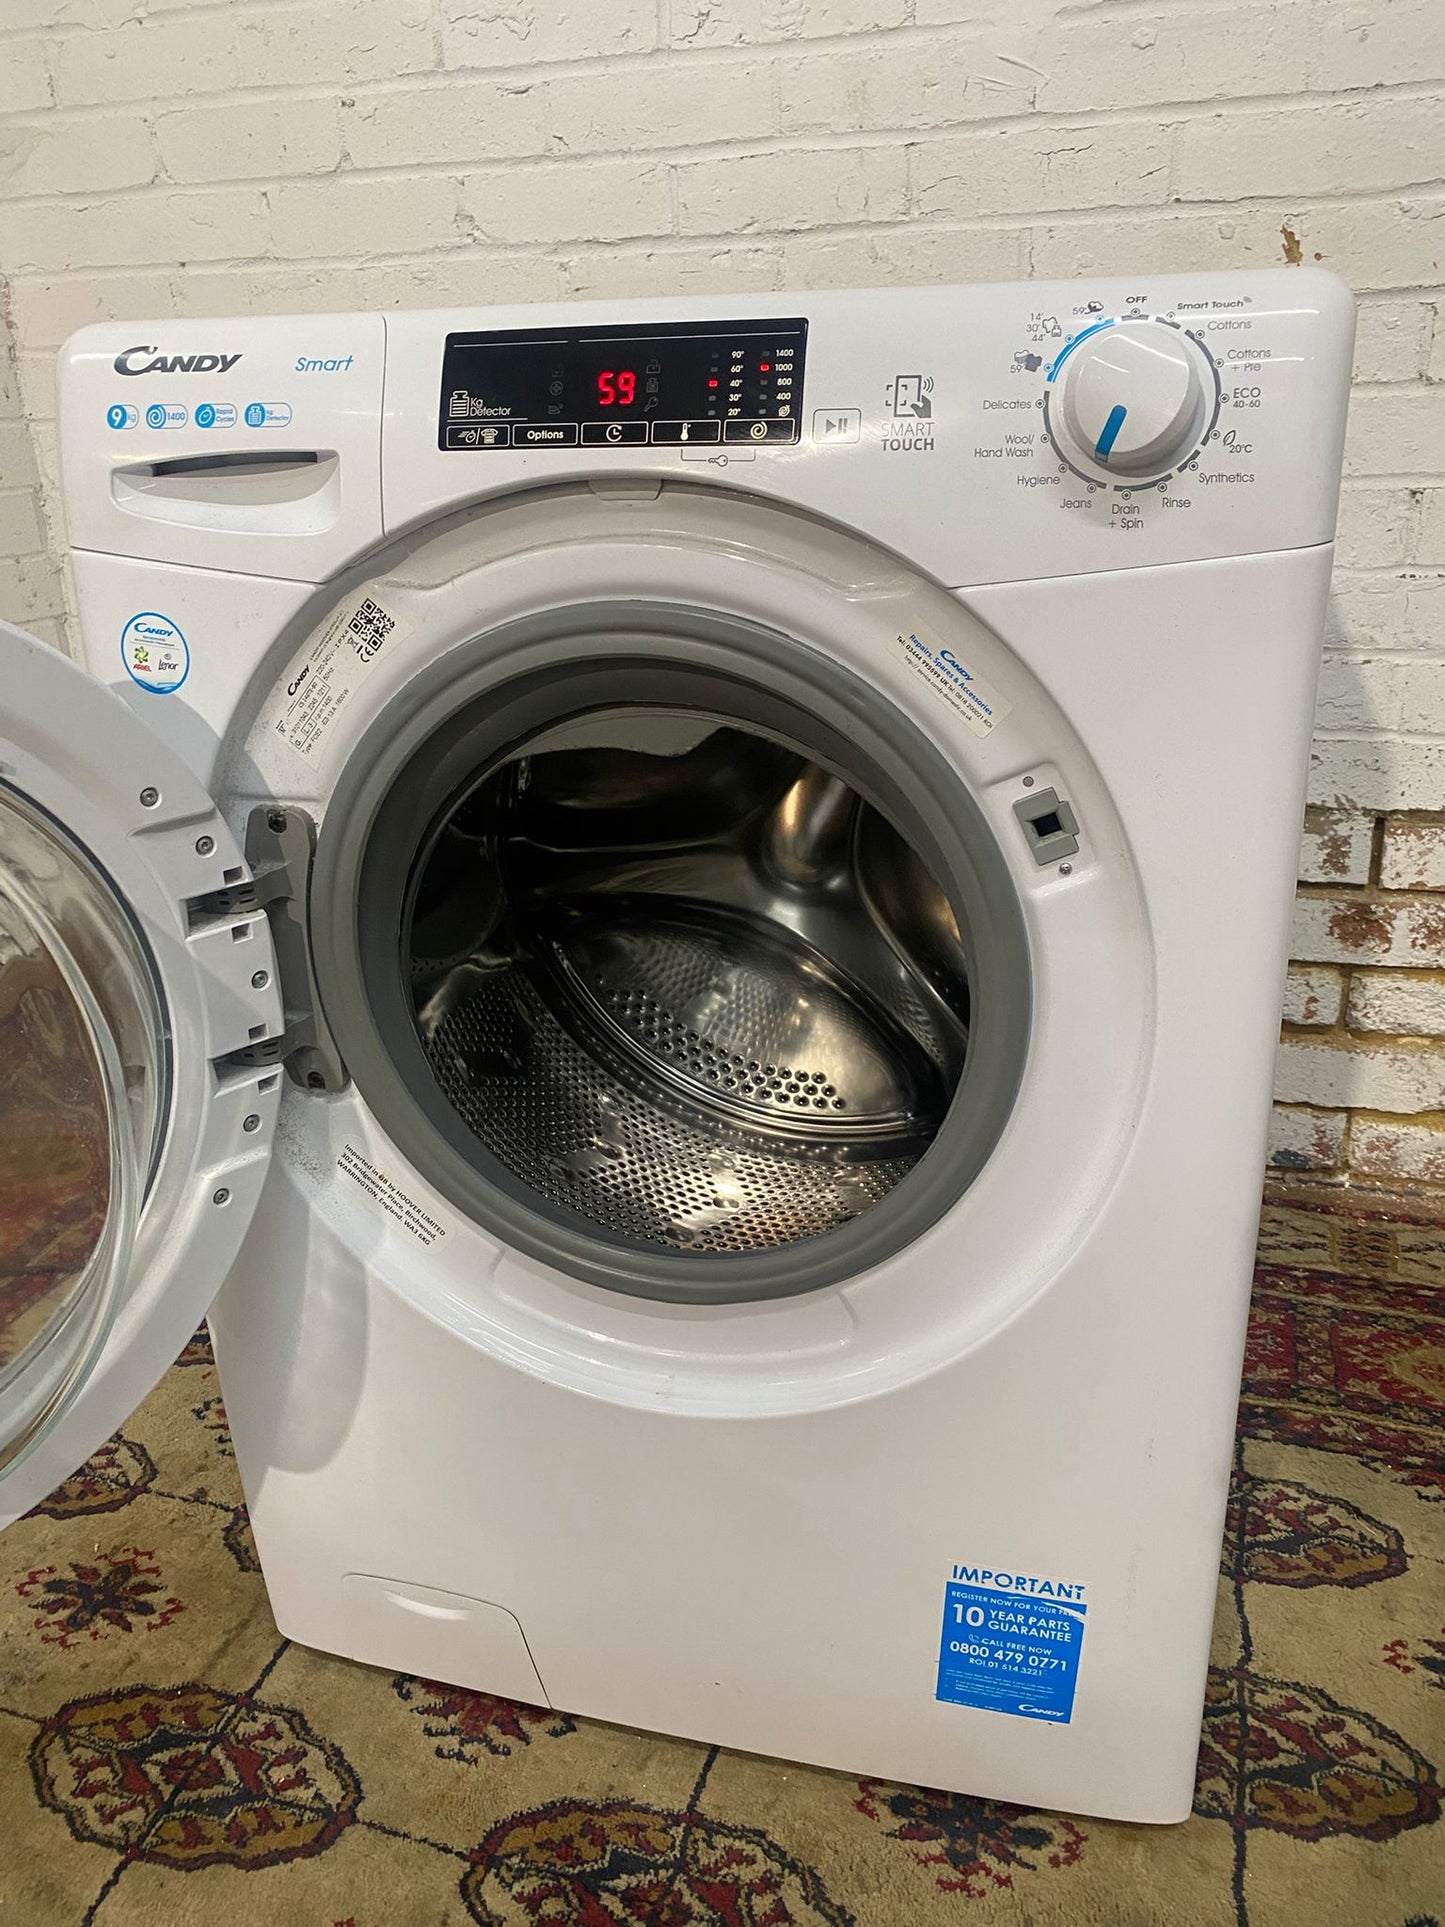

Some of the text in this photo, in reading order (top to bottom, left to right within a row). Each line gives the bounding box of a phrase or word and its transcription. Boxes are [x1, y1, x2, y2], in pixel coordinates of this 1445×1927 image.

[1125, 296, 1148, 304] OFF
[1177, 300, 1244, 310] Smart Touch
[1207, 320, 1252, 331] Cottons
[776, 349, 794, 357] 1400
[1227, 349, 1271, 360] Cottons
[295, 354, 354, 373] Smart
[775, 363, 793, 372] 1000
[1243, 362, 1262, 372] Pre
[597, 371, 636, 405] 59
[777, 378, 792, 386] 800
[776, 392, 791, 400] 400
[1233, 387, 1261, 399] ECO
[470, 397, 483, 408] Kg
[983, 400, 1032, 410] Delicates
[1233, 400, 1261, 408] 40-60
[111, 408, 122, 426] 9
[167, 411, 185, 421] 1400
[470, 406, 511, 416] Detector
[527, 430, 564, 441] Options
[880, 421, 935, 438] SMART
[880, 437, 935, 451] TOUCH
[1229, 444, 1253, 453] 20°C
[974, 447, 1033, 458] Hand Wash
[1017, 475, 1061, 487] Hygiene
[1198, 472, 1255, 485] Synthetics
[1060, 498, 1093, 509] Jeans
[1162, 496, 1191, 508] Rinse
[1111, 503, 1140, 515] Drain
[1120, 517, 1144, 530] Spin
[909, 634, 933, 659] Repairs,
[932, 657, 954, 679] Spares
[959, 682, 993, 715] Accessories
[940, 678, 948, 686] UK
[341, 1152, 436, 1240] 302 Bridgewater Place, Birchwood,
[344, 1144, 373, 1170] Imported
[371, 1169, 379, 1177] in
[387, 1183, 397, 1192] by
[396, 1191, 421, 1213] HOOVER
[421, 1213, 446, 1236] LIMITED
[337, 1159, 379, 1199] WARRINGTON,
[404, 1221, 418, 1234] WA3
[417, 1234, 431, 1245] 6XG
[952, 1564, 1085, 1600] IMPORTANT
[951, 1590, 988, 1603] REGISTER
[990, 1597, 1011, 1606] NOW
[1014, 1601, 1031, 1610] FOR
[1034, 1604, 1057, 1614] YOUR
[953, 1603, 1070, 1631] 10 YEAR PARTS
[988, 1620, 1072, 1642] GUARANTEE
[981, 1637, 1052, 1656] CALL FREE NOW
[950, 1641, 1067, 1672] 0800 479 0771
[988, 1660, 999, 1668] 01
[1021, 1667, 1043, 1676] 3221
